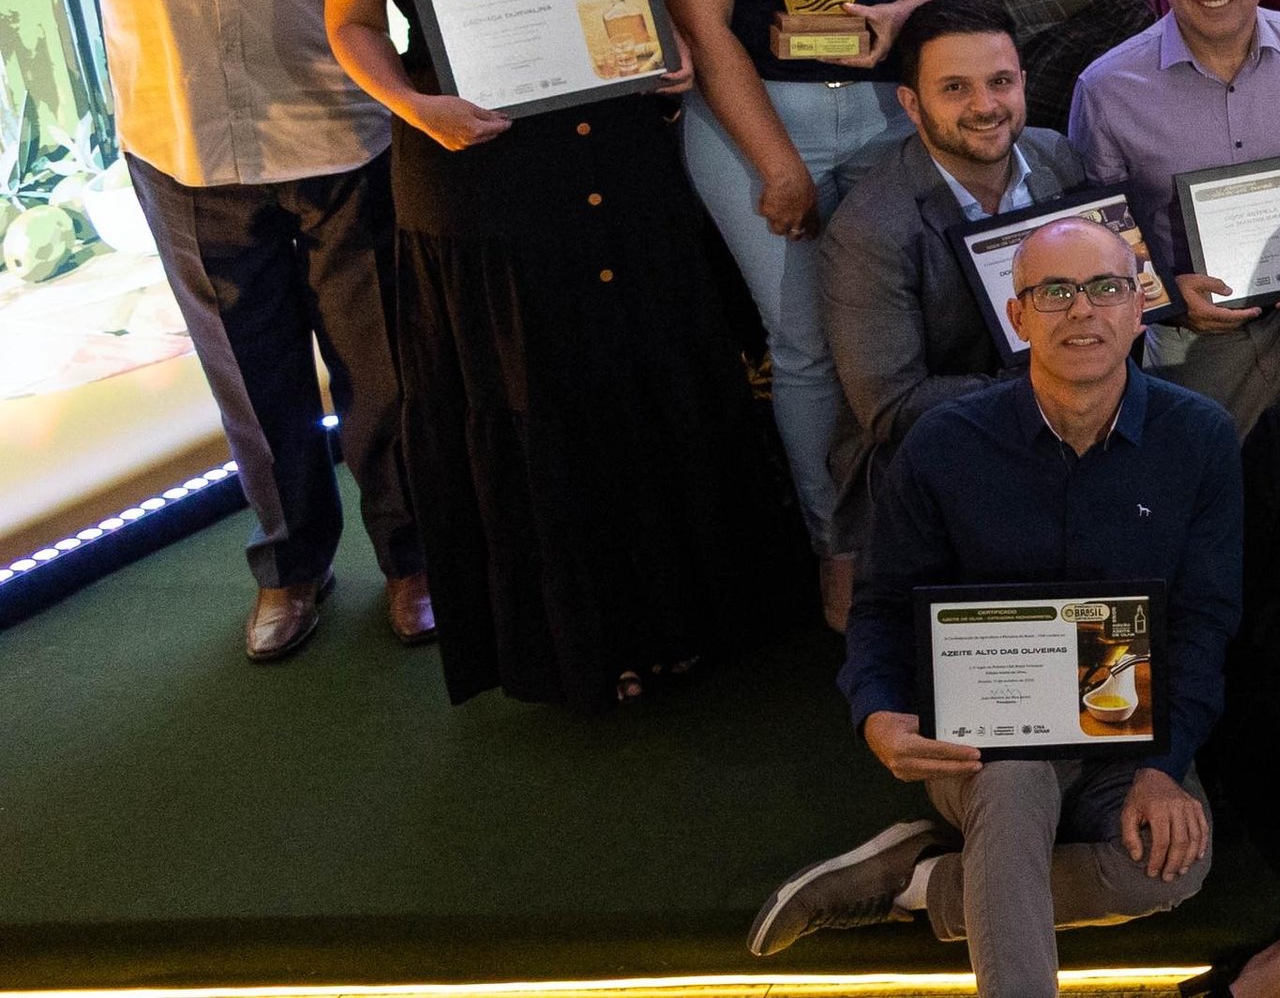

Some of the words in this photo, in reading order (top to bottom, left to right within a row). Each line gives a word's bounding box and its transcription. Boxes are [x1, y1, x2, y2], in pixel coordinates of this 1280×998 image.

[1075, 607, 1103, 617] BRASIL
[941, 649, 972, 657] AZEITE
[975, 648, 998, 656] ALTO
[1021, 647, 1067, 655] OLIVEIRAS
